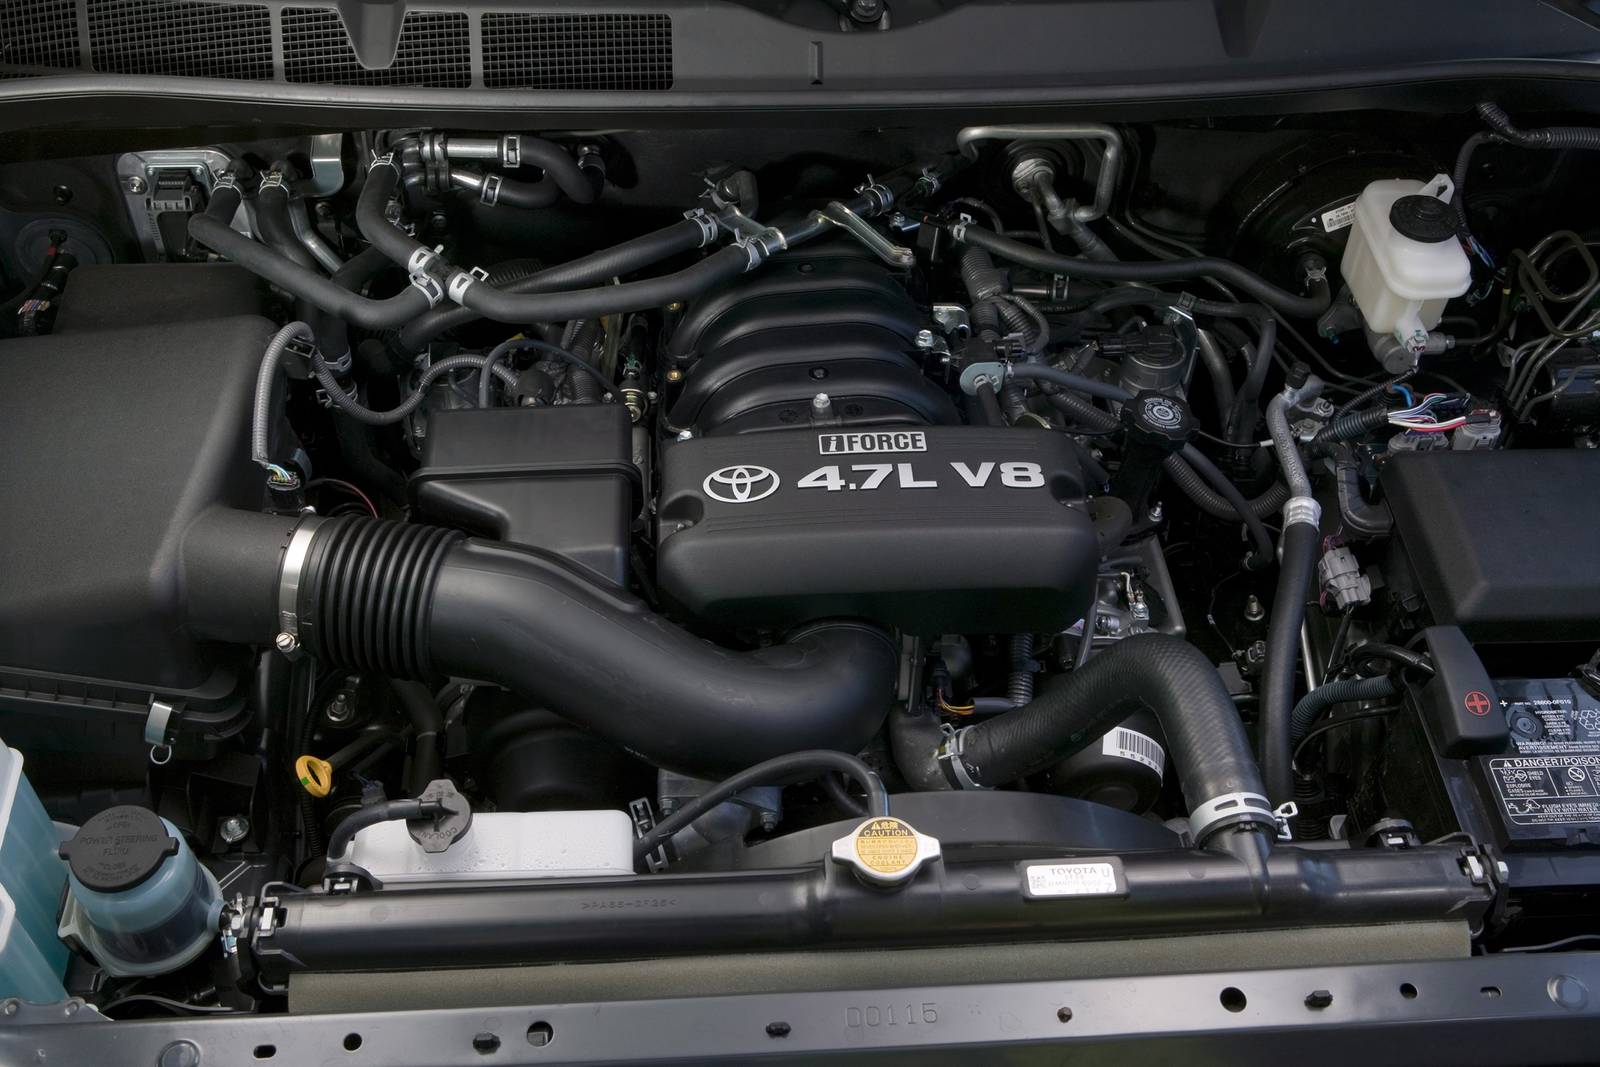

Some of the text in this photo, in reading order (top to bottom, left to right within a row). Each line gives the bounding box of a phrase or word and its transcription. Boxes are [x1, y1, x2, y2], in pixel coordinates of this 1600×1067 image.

[798, 461, 1045, 491] 4.7L V8
[115, 834, 158, 845] STEERING
[1050, 867, 1097, 875] TOYOTA
